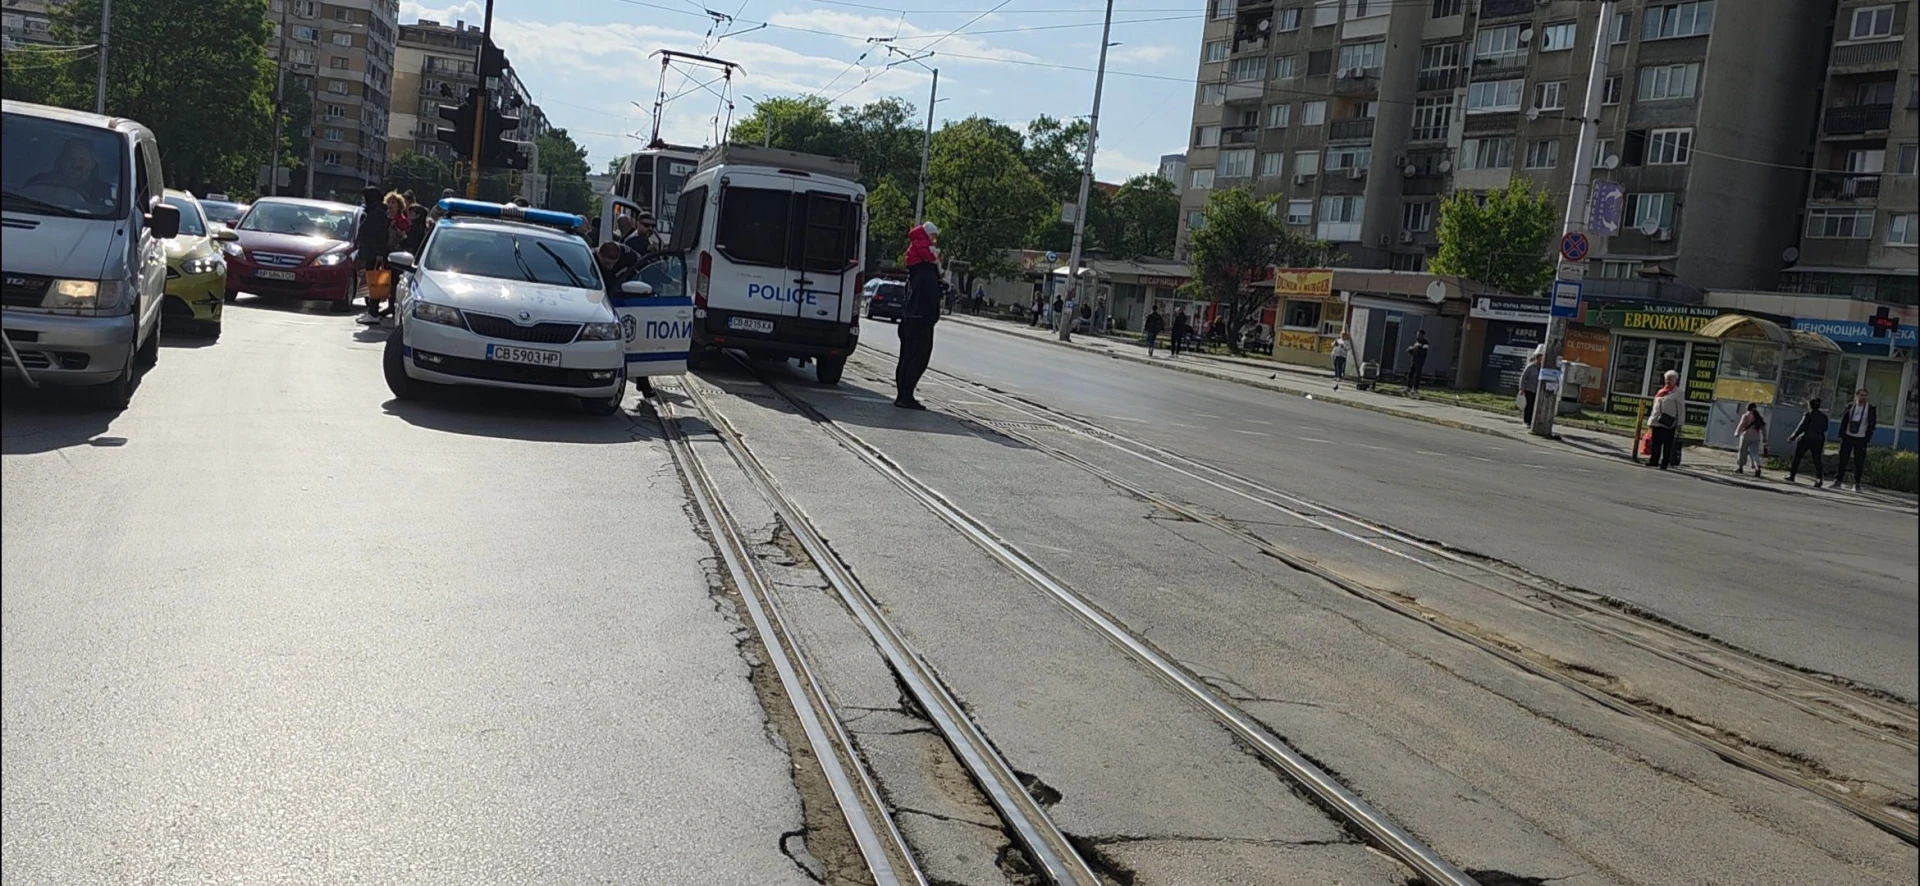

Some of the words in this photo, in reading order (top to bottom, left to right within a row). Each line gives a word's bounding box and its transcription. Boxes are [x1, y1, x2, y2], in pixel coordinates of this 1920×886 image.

[1303, 278, 1330, 293] BURGER
[748, 283, 817, 305] POLICE
[1643, 304, 1688, 315] ЗАЛОЖНИ
[1689, 307, 1719, 316] КЪЩИ
[646, 320, 692, 339] ПОЛИ
[1515, 328, 1537, 338] КИРОВ
[1797, 322, 1868, 337] ДЕНОНОЩНА
[494, 348, 511, 359] CB
[513, 349, 541, 363] 5903
[542, 352, 559, 363] HP
[1695, 359, 1716, 368] ЗЛАТО
[1696, 370, 1711, 379] GSM
[1690, 390, 1711, 400] ДРУГИ
